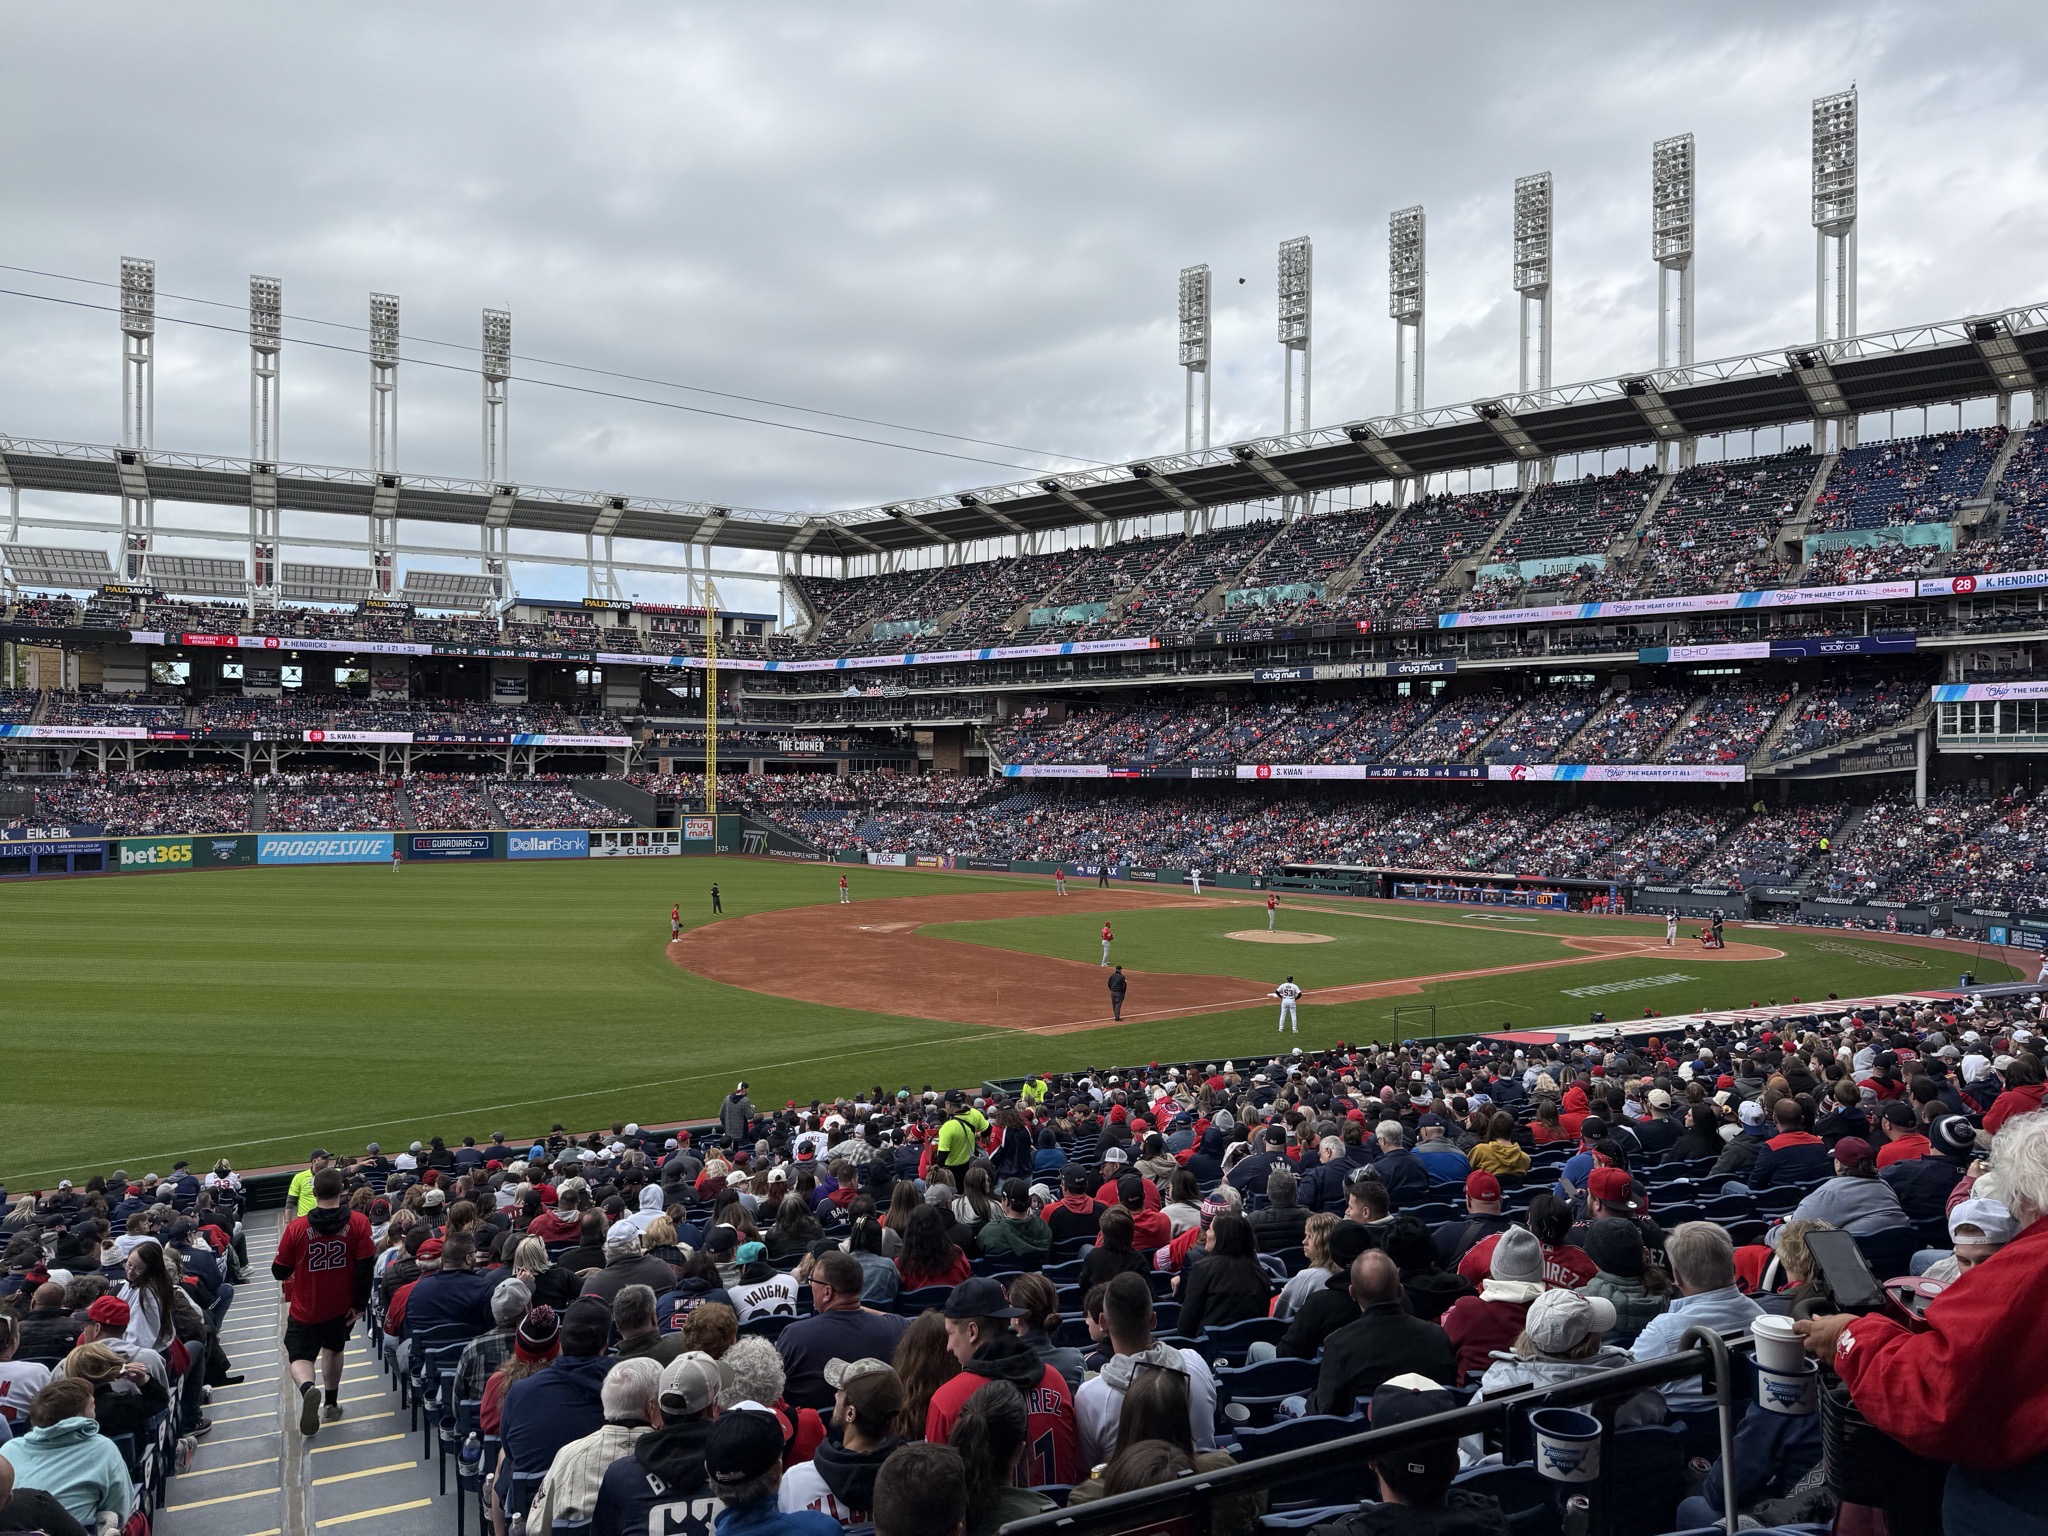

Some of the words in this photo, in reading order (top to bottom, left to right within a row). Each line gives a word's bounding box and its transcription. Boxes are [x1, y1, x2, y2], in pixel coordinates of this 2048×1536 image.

[1817, 539, 1850, 551] FLICK
[1543, 563, 1573, 574] LAJOIE
[1957, 580, 1971, 590] 28
[1986, 579, 1995, 587] K.
[105, 586, 153, 595] PAULDAVIS
[366, 601, 409, 609] PAULDAVIS
[584, 600, 631, 610] PAULDAVIS
[635, 602, 678, 614] PENNANT
[1673, 648, 1707, 656] ECHO
[1820, 643, 1843, 652] VICTORY
[1844, 643, 1860, 651] CLUB
[1313, 664, 1362, 679] CHAMPIONS
[1364, 663, 1387, 677] CLUB
[1398, 664, 1420, 674] drug
[1422, 663, 1444, 671] mart
[1262, 671, 1281, 681] drug
[1281, 670, 1300, 679] mart
[778, 741, 793, 752] THE
[794, 741, 825, 752] CORNER
[1875, 745, 1893, 754] drug
[1894, 743, 1913, 752] mart
[1839, 754, 1890, 772] CHAMPIONS
[1892, 752, 1915, 766] CLUB
[1259, 768, 1268, 776] 38
[1276, 768, 1282, 776] S.
[1283, 768, 1303, 776] KWAN
[1381, 768, 1397, 777] .307
[1413, 768, 1429, 777] .783
[1443, 768, 1450, 777] 4
[1470, 768, 1478, 777] 19
[687, 818, 709, 830] drug
[26, 828, 71, 839] Elk+Elk
[689, 829, 713, 837] mart
[260, 839, 385, 857] PROGRESSIVE
[627, 847, 670, 855] CLIFFS
[120, 845, 192, 865] bet365
[875, 853, 895, 864] ROSE
[1087, 866, 1117, 875] RE/AX
[1644, 885, 1680, 894] PROGRESSIVE
[1691, 888, 1729, 896] PROGRESSIVE
[1815, 896, 1854, 905] PROGRESSIVE
[1866, 900, 1907, 909] PROGRESSIVE
[1971, 908, 2010, 918] PROGRESSIVE
[1560, 972, 1701, 999] PROGRESSIVE
[1283, 989, 1294, 997] 53
[309, 1240, 347, 1272] 22
[1544, 1256, 1580, 1290] ÍREZ
[744, 1284, 789, 1308] VAUGHN
